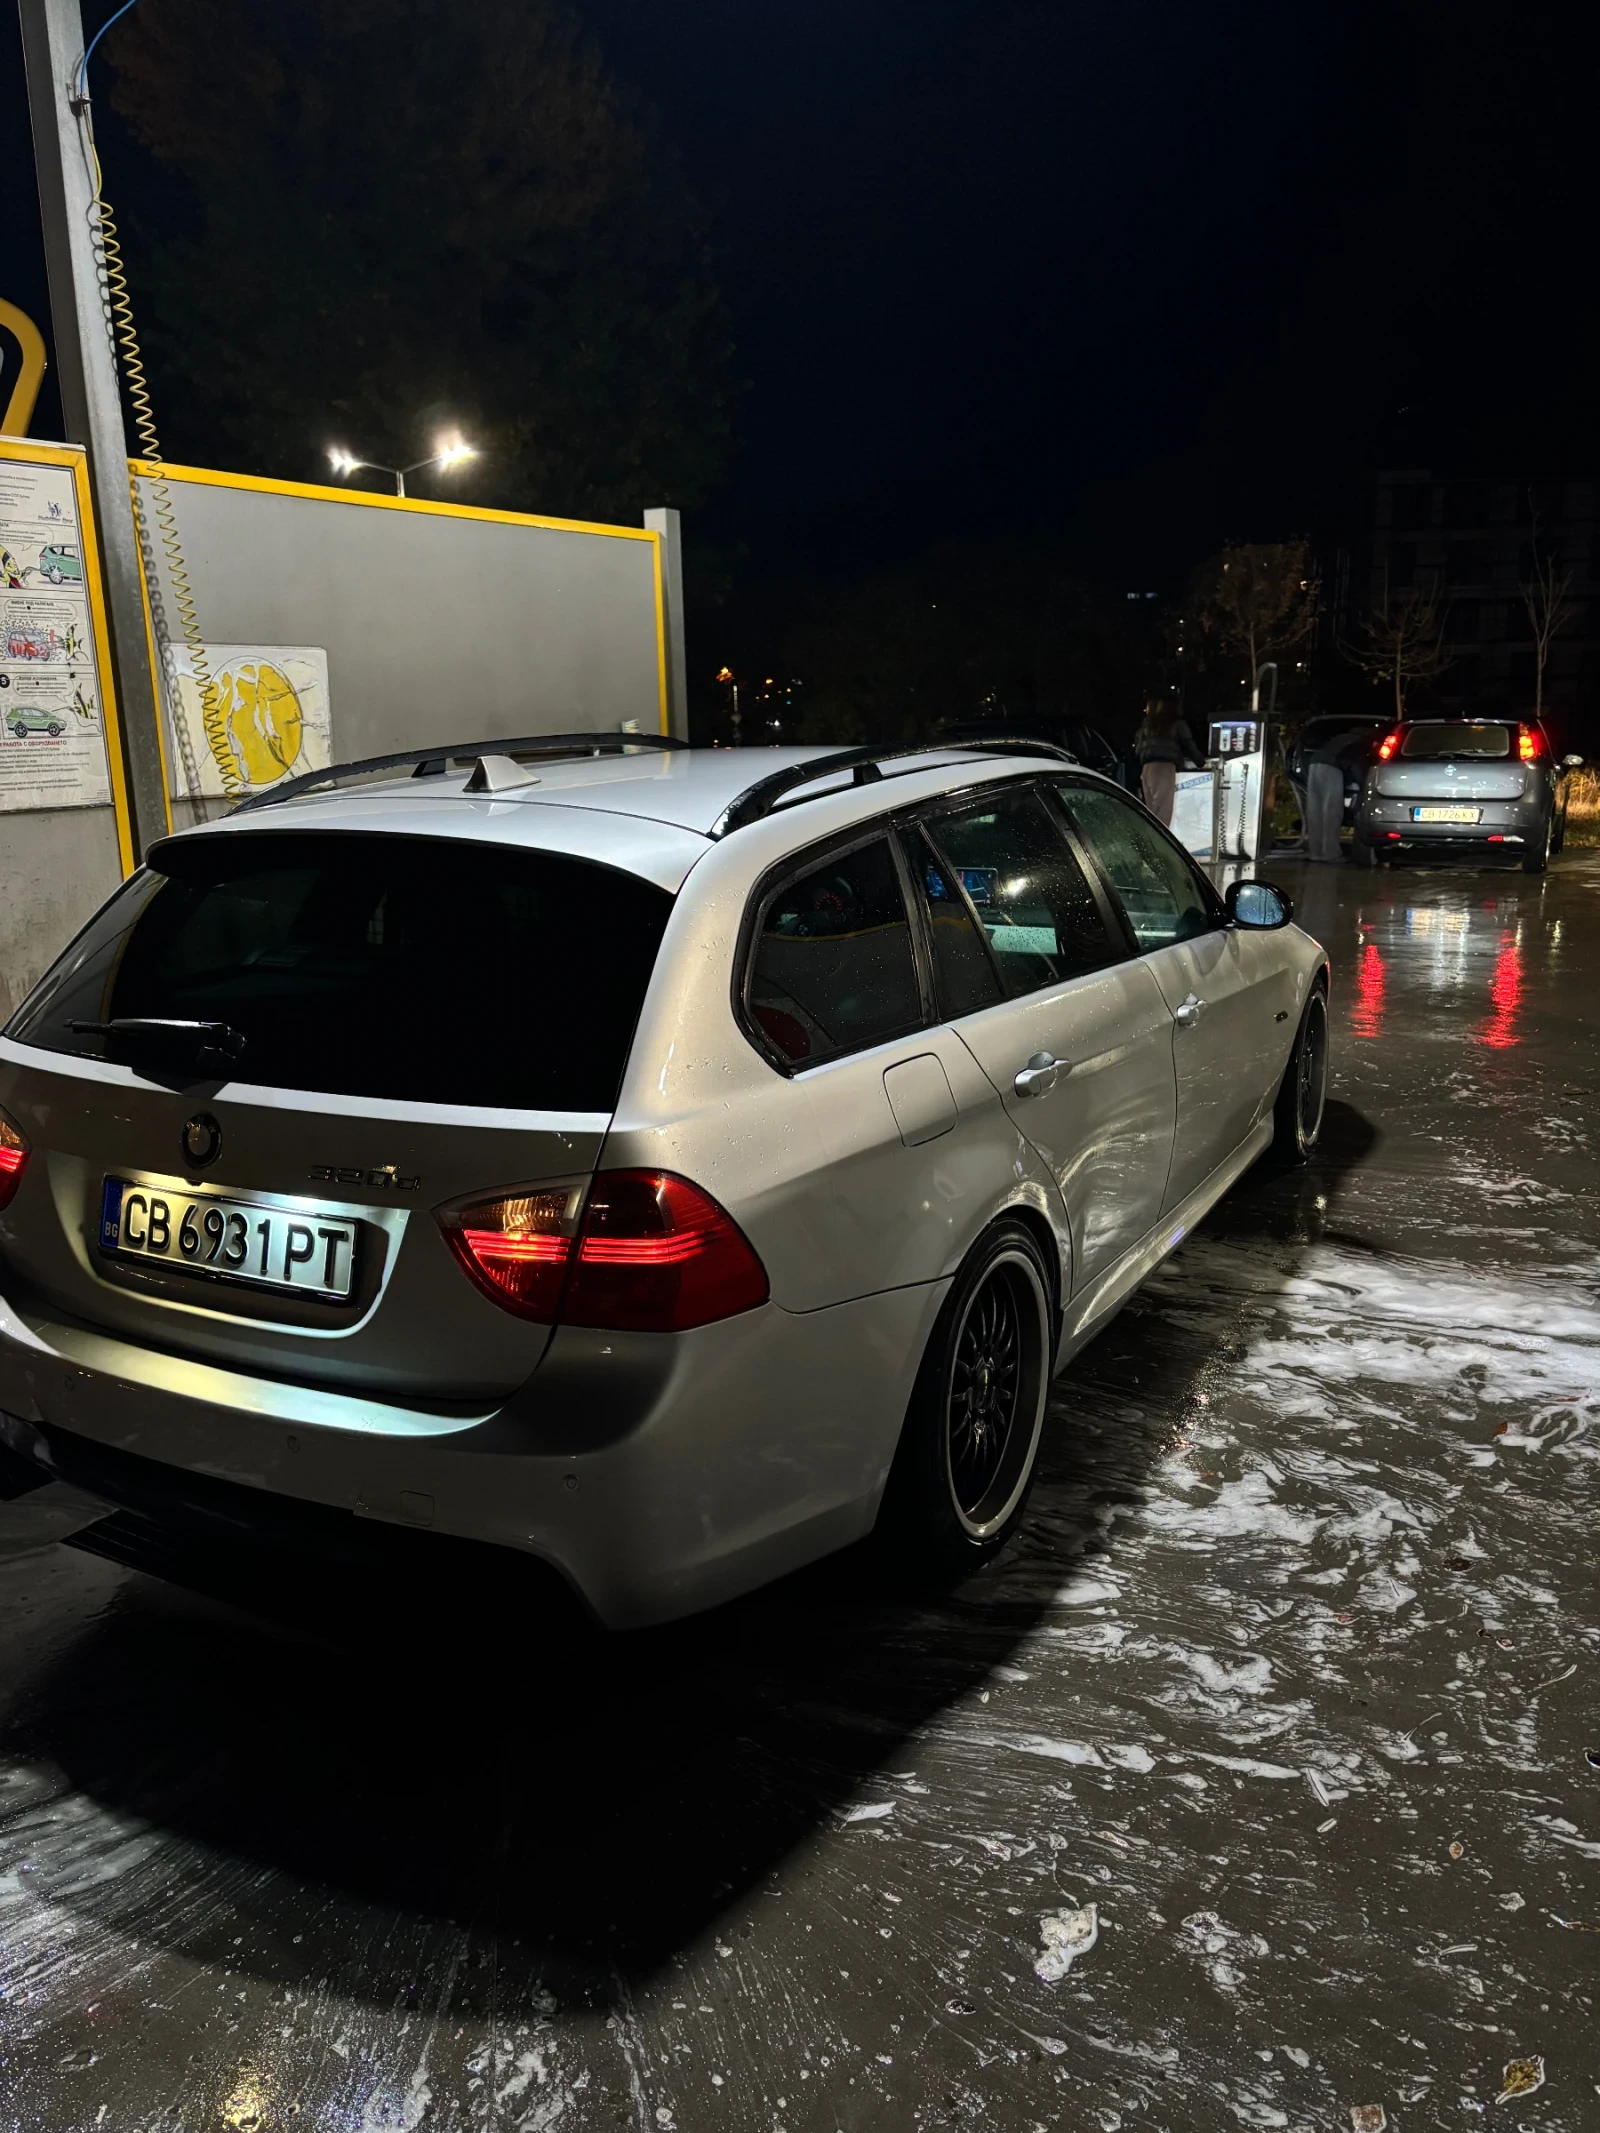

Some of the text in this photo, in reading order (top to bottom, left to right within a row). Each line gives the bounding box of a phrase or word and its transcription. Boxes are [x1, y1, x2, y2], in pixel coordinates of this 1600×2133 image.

[308, 1165, 421, 1192] 320d
[104, 1221, 118, 1238] BG
[179, 1204, 271, 1276] 6931
